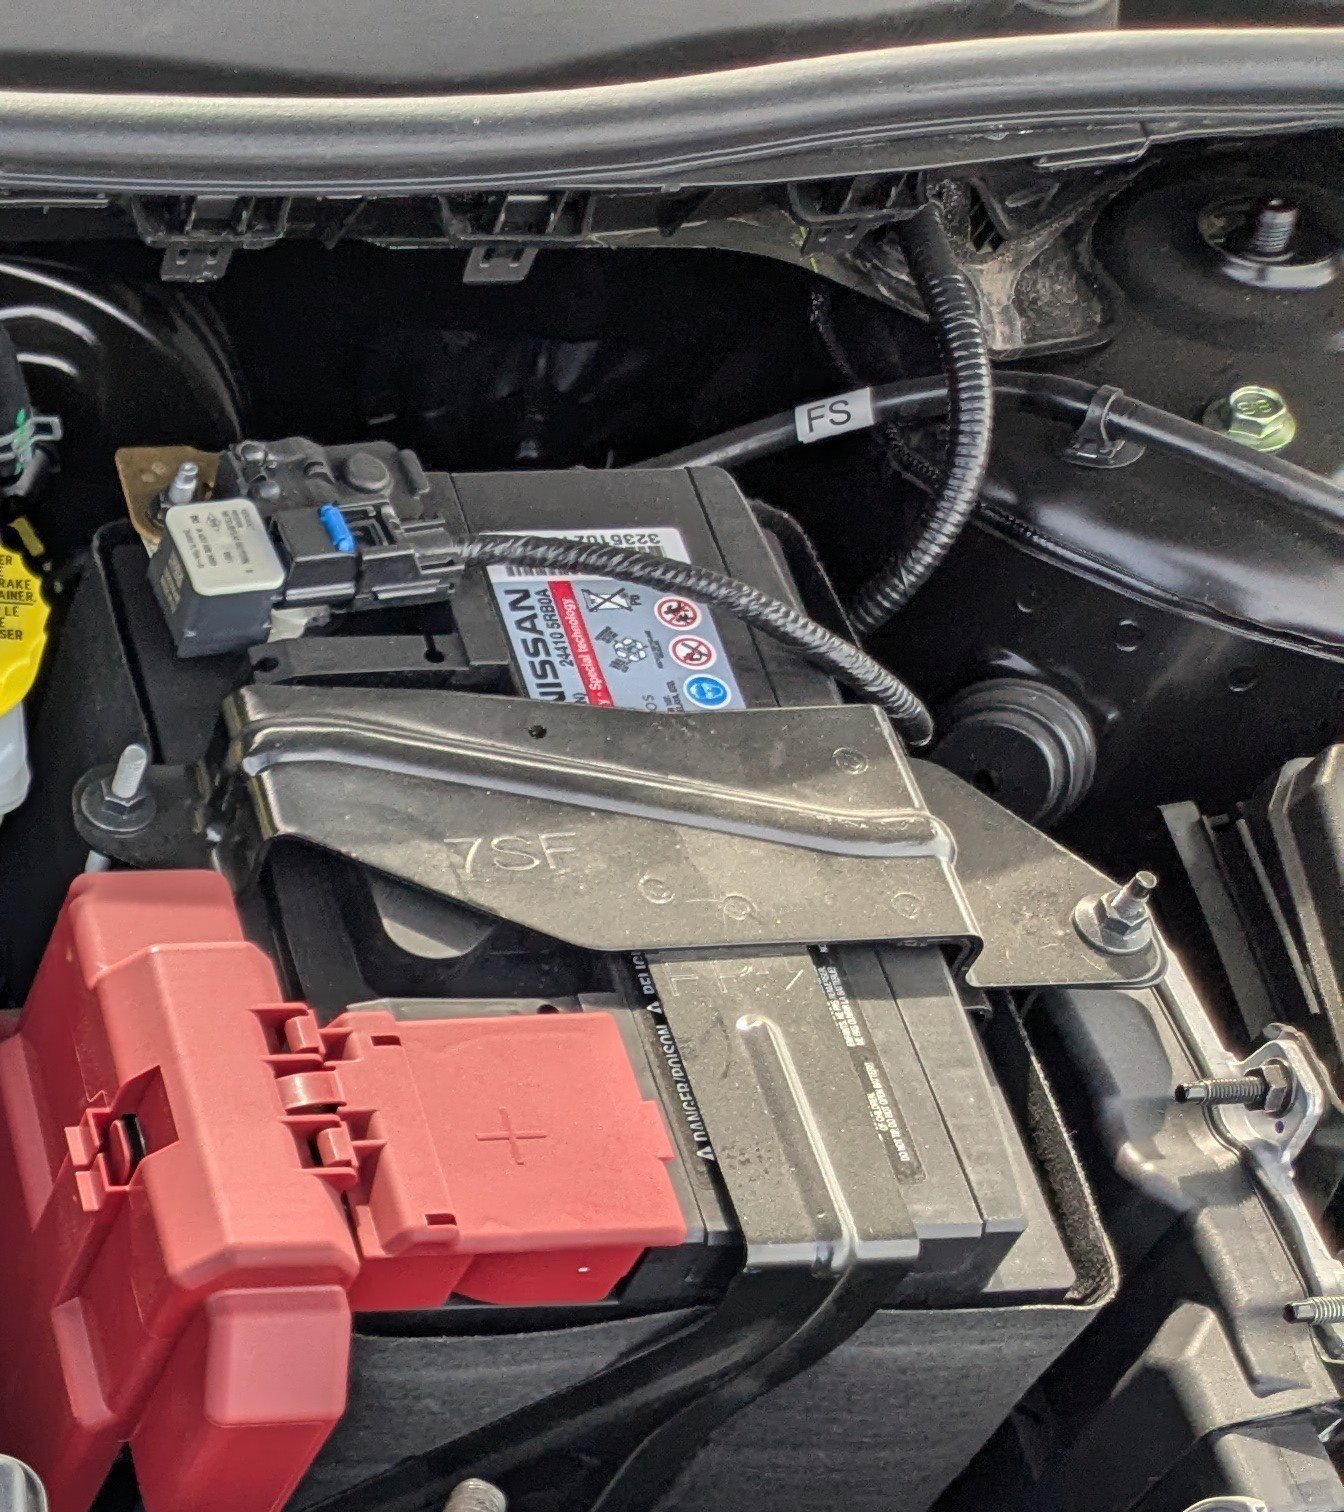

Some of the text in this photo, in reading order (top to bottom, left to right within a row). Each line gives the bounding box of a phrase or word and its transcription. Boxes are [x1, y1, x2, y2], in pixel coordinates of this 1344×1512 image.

[807, 400, 851, 433] FS
[5, 606, 20, 617] LE
[550, 630, 574, 667] 24410
[561, 598, 603, 690] Special technology
[443, 832, 576, 874] 7SF
